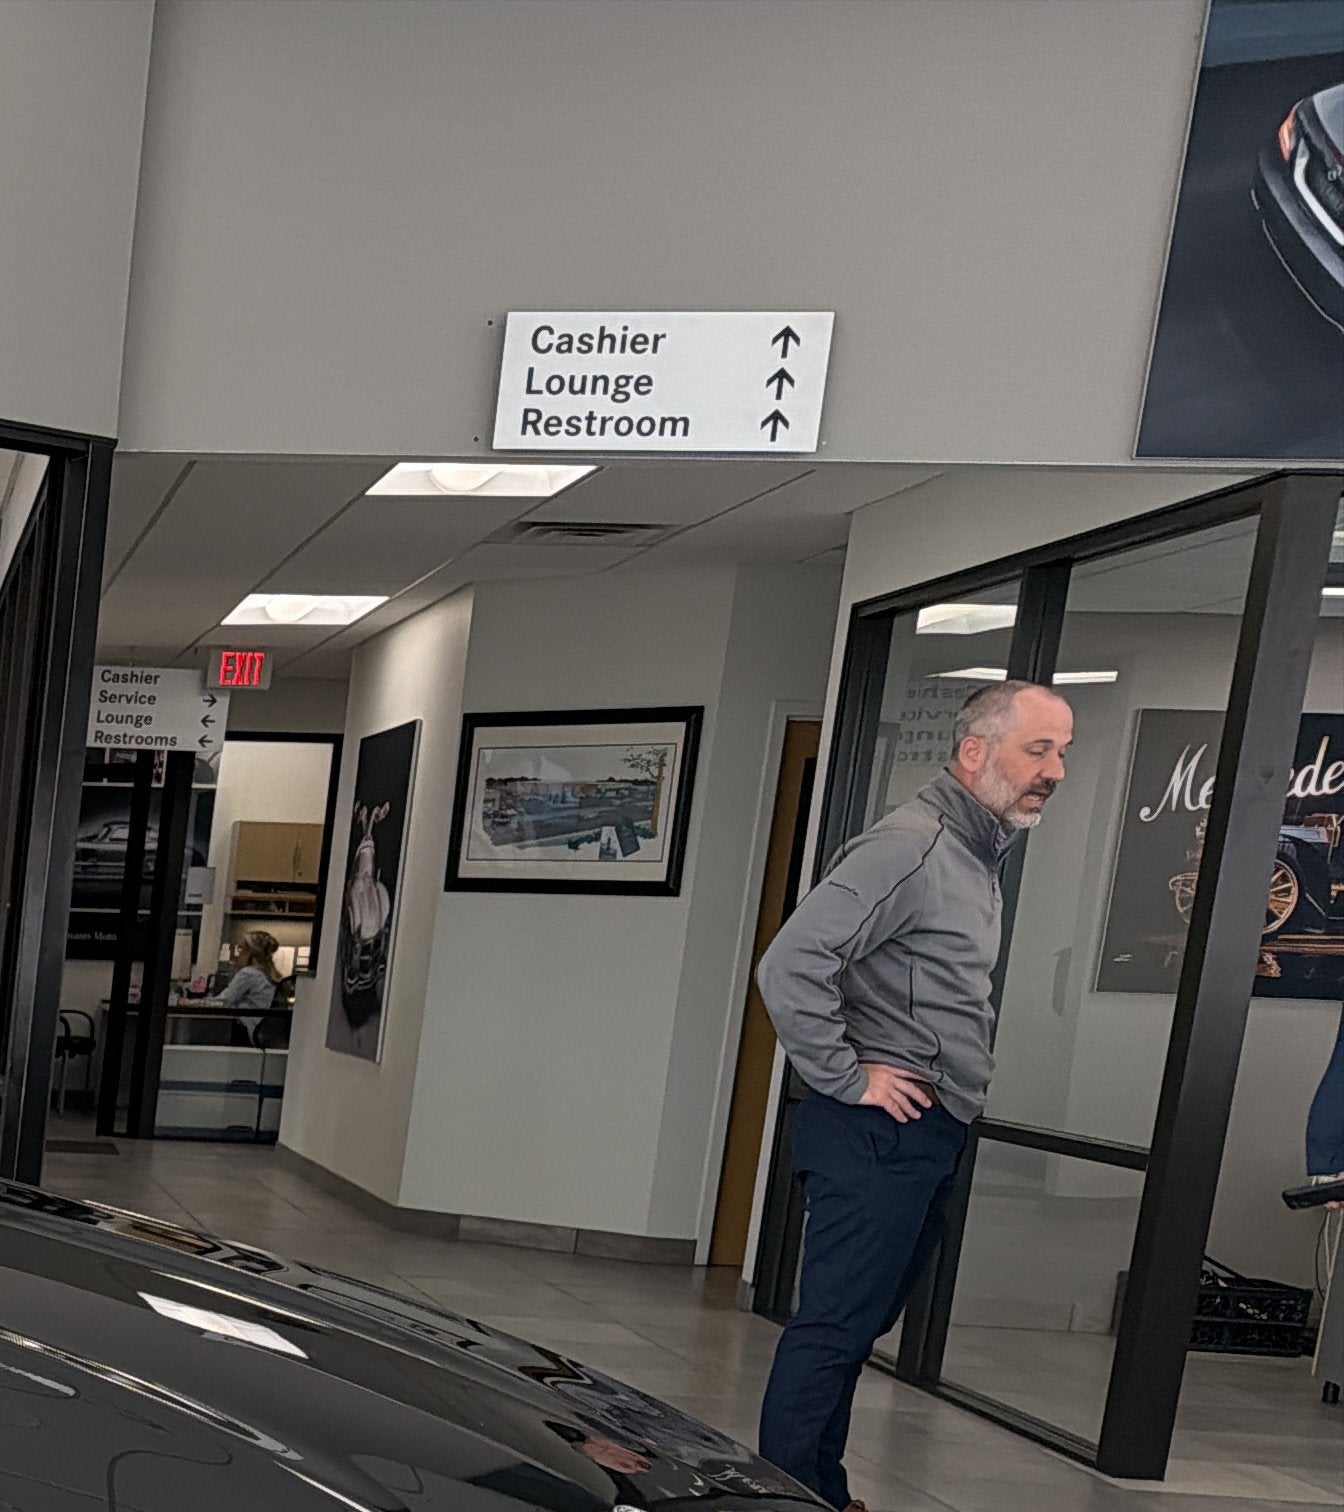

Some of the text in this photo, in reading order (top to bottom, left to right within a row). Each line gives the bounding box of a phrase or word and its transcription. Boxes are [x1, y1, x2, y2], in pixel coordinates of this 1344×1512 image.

[531, 325, 667, 355] Cashier
[525, 366, 654, 403] Lounge
[520, 407, 691, 437] Restroom
[100, 669, 161, 686] Cashier
[219, 651, 266, 686] EXIT
[98, 690, 157, 705] Service
[96, 710, 153, 728] Lounge
[93, 730, 178, 746] Restrooms
